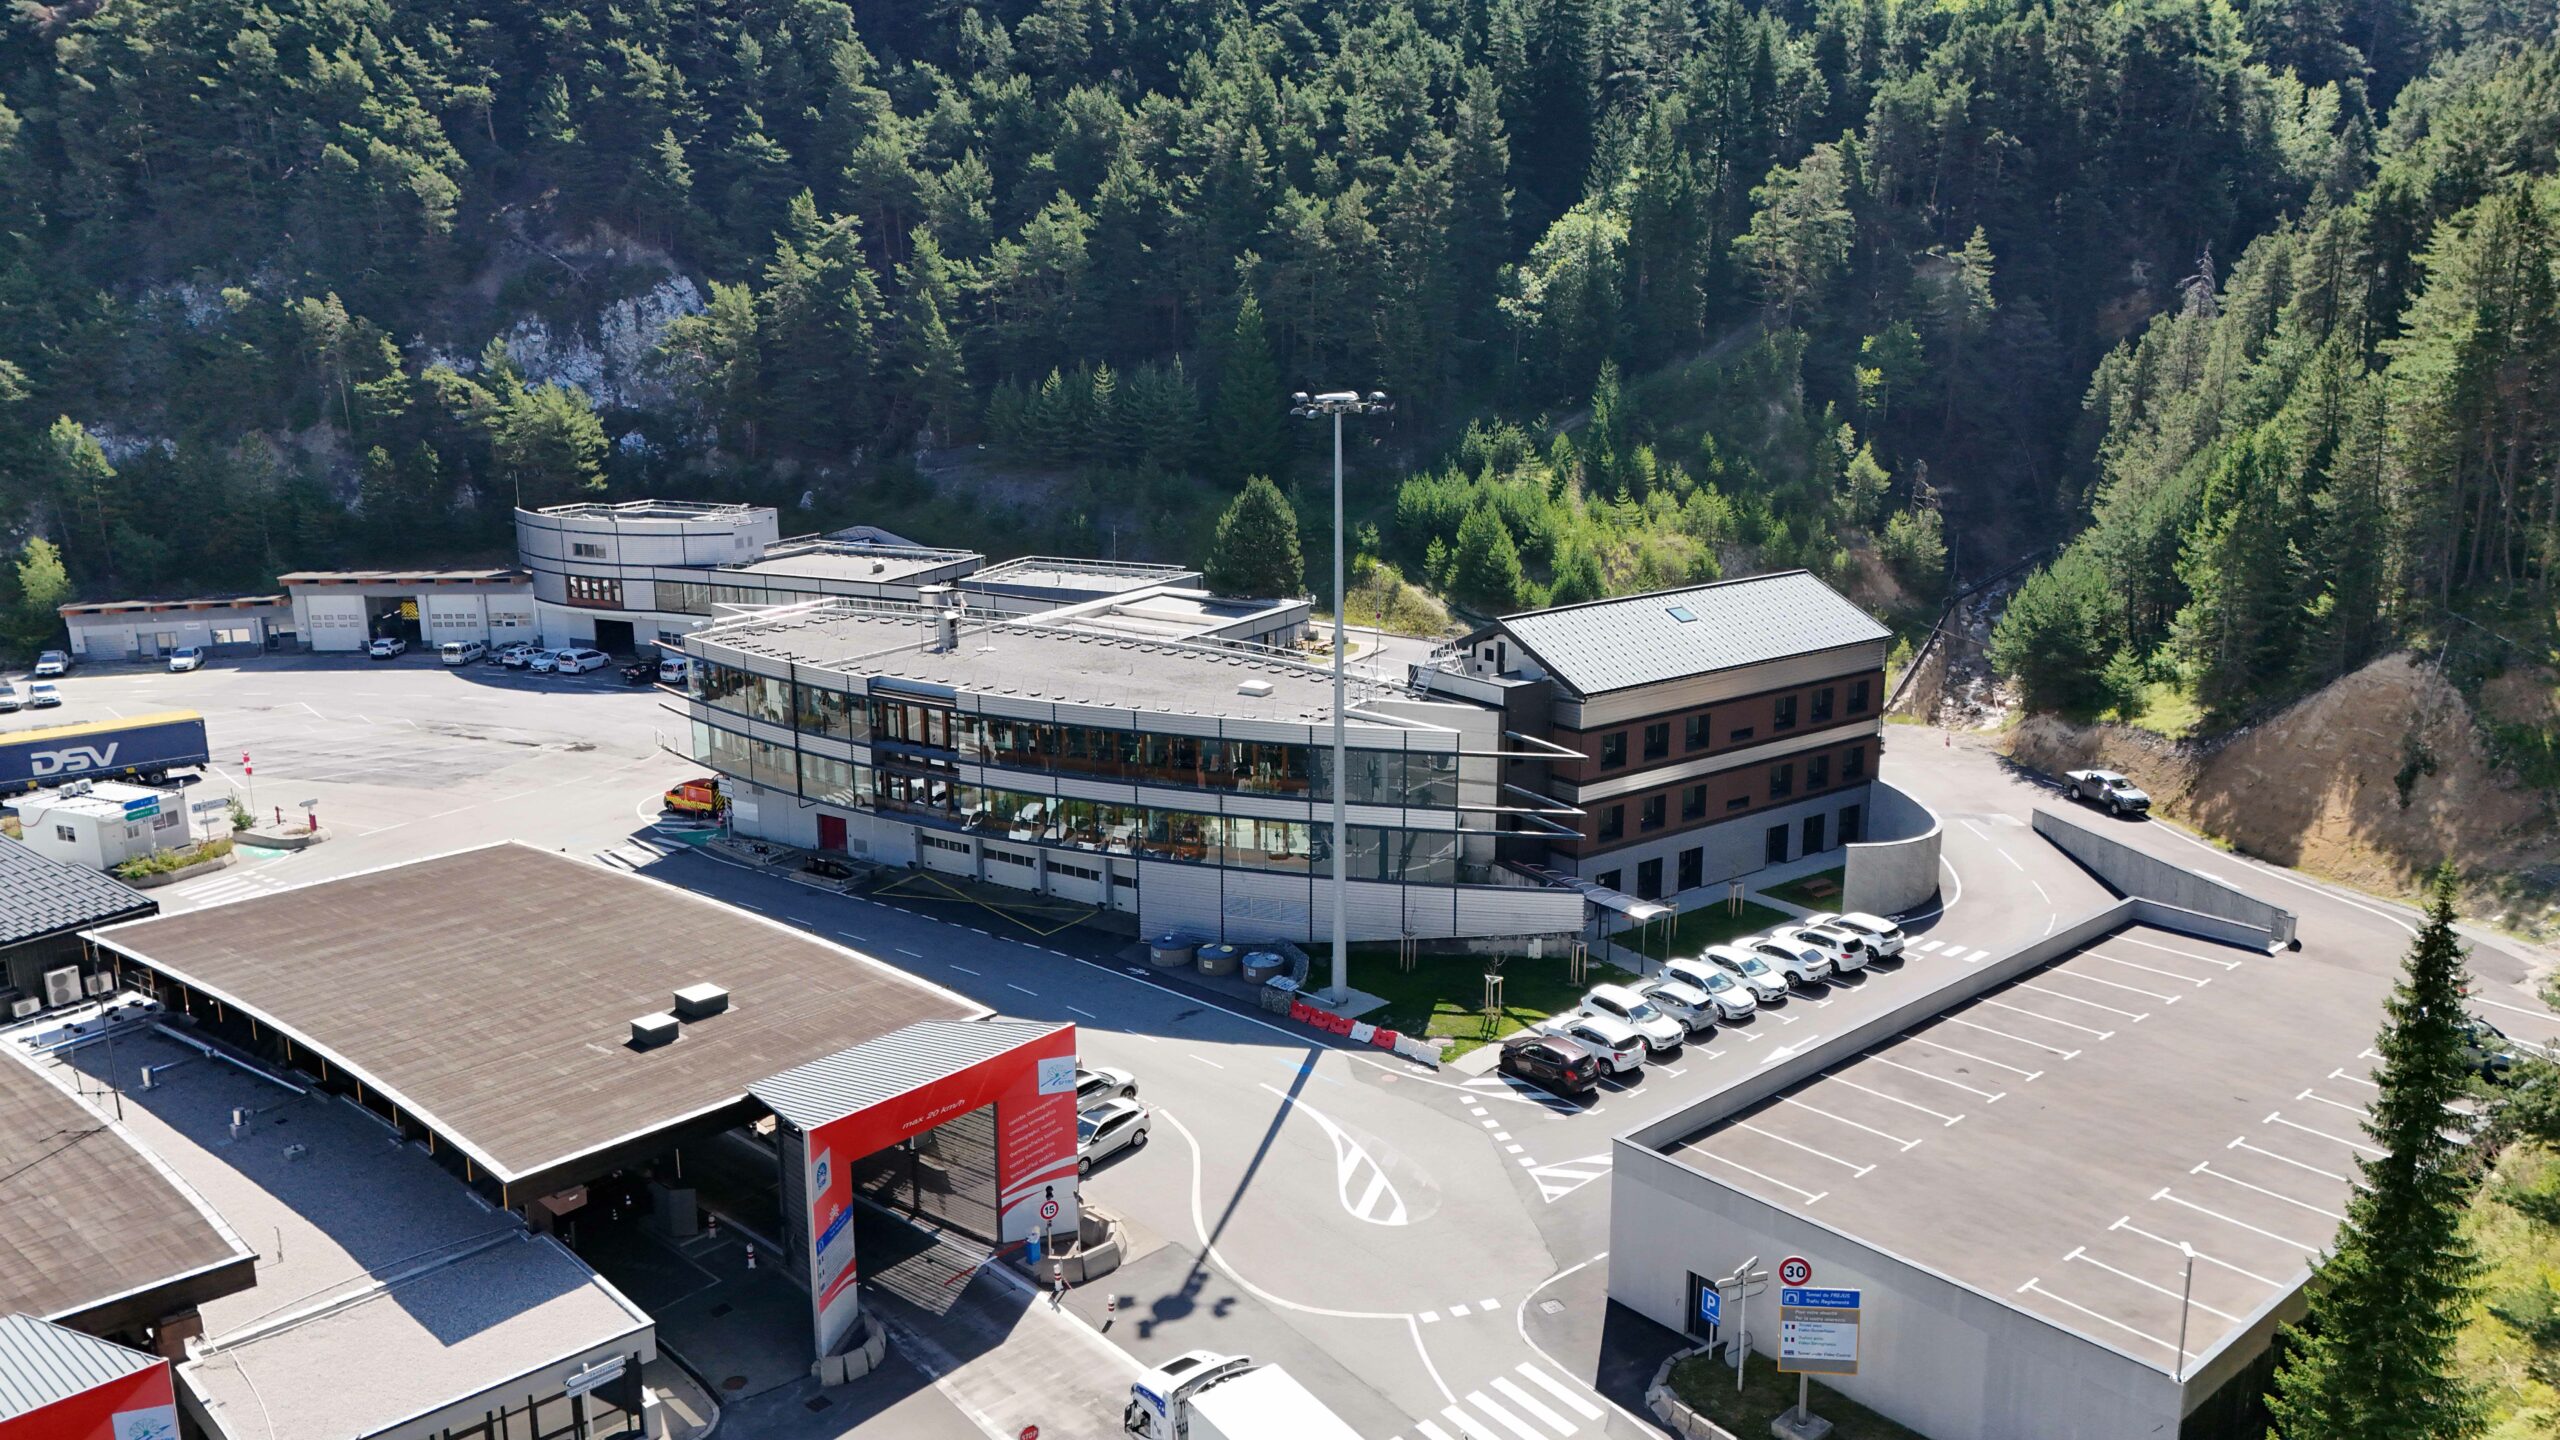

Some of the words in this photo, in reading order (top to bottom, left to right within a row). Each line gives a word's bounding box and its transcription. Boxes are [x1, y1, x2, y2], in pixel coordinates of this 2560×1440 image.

[30, 742, 119, 776] DSV
[902, 1116, 924, 1130] max
[926, 1109, 940, 1120] 20
[940, 1099, 966, 1114] km/h
[1044, 1205, 1055, 1215] 15
[1785, 1265, 1806, 1278] 30
[1706, 1294, 1716, 1310] P
[1021, 1431, 1038, 1440] STOP
